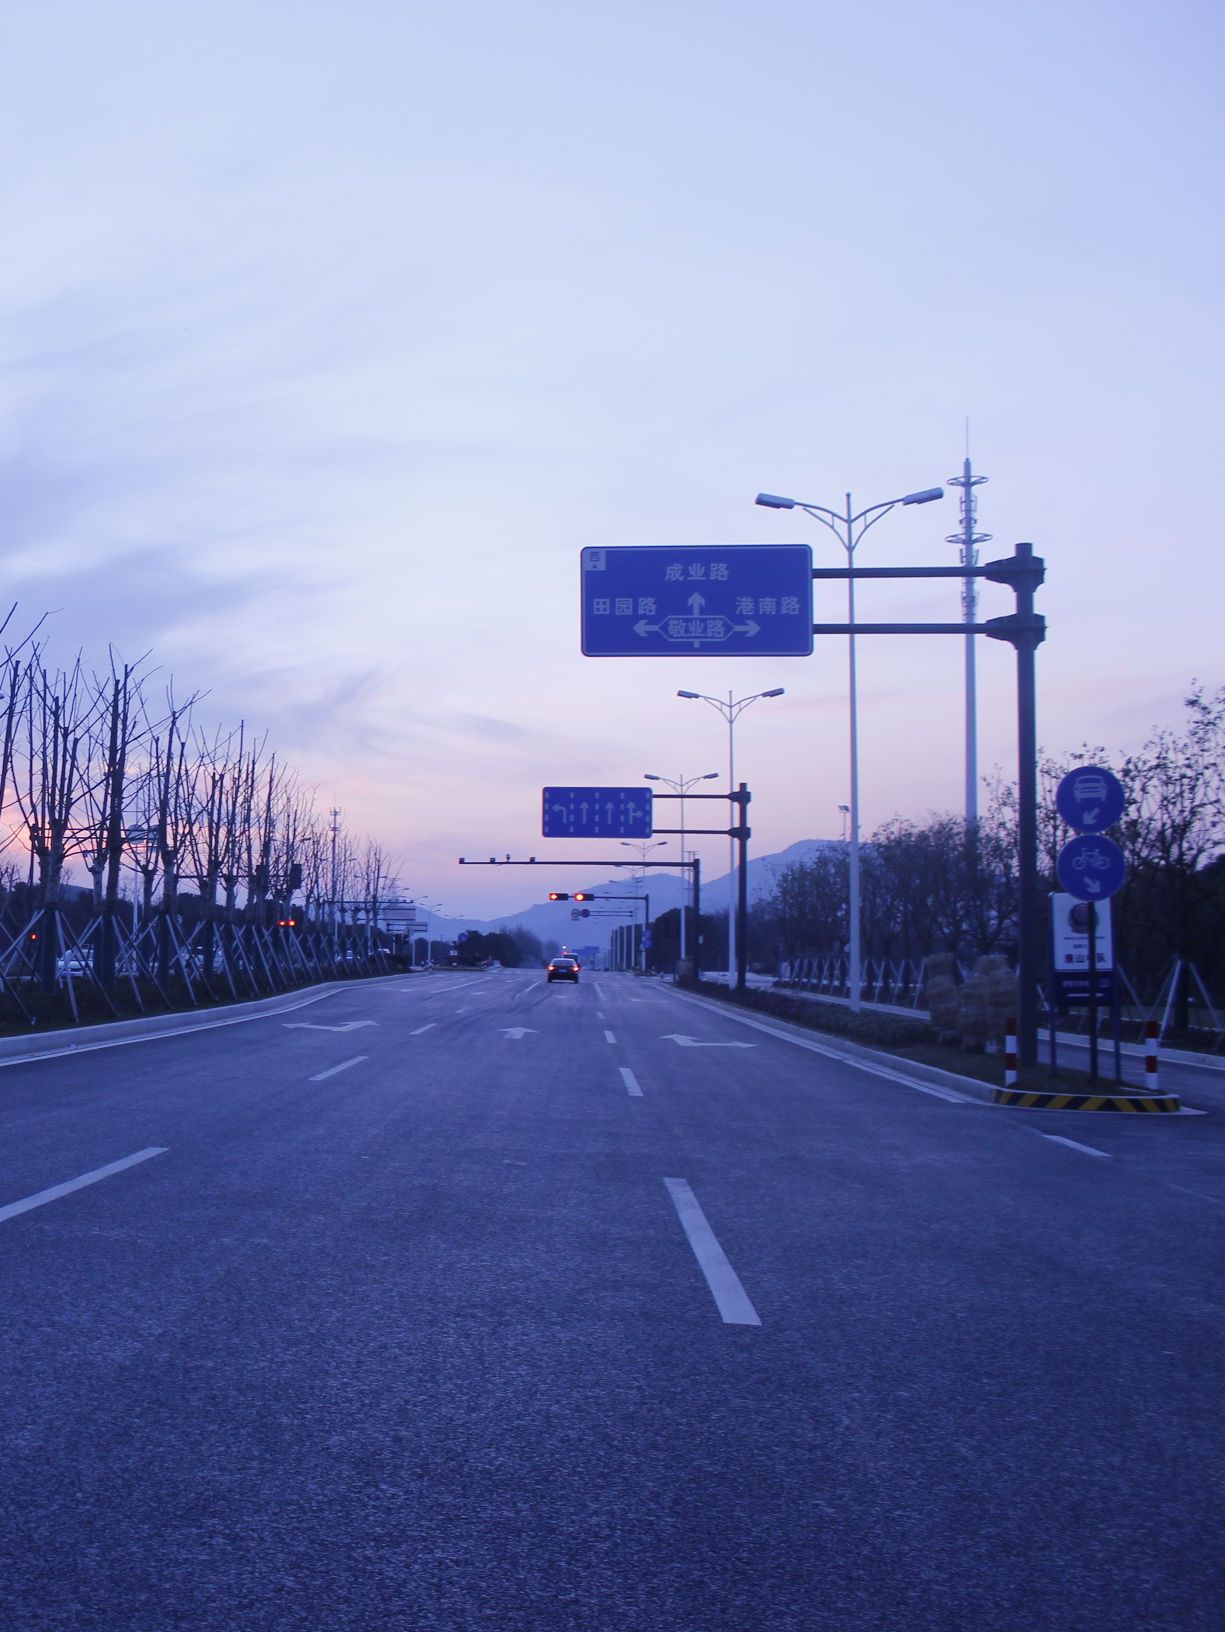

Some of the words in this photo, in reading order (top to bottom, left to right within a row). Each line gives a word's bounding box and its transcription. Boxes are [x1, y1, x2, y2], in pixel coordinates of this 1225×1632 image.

[590, 552, 600, 562] 西
[664, 563, 728, 581] 成业路
[593, 597, 657, 615] 田园路
[736, 597, 800, 615] 港南路
[668, 619, 726, 638] 敬业路
